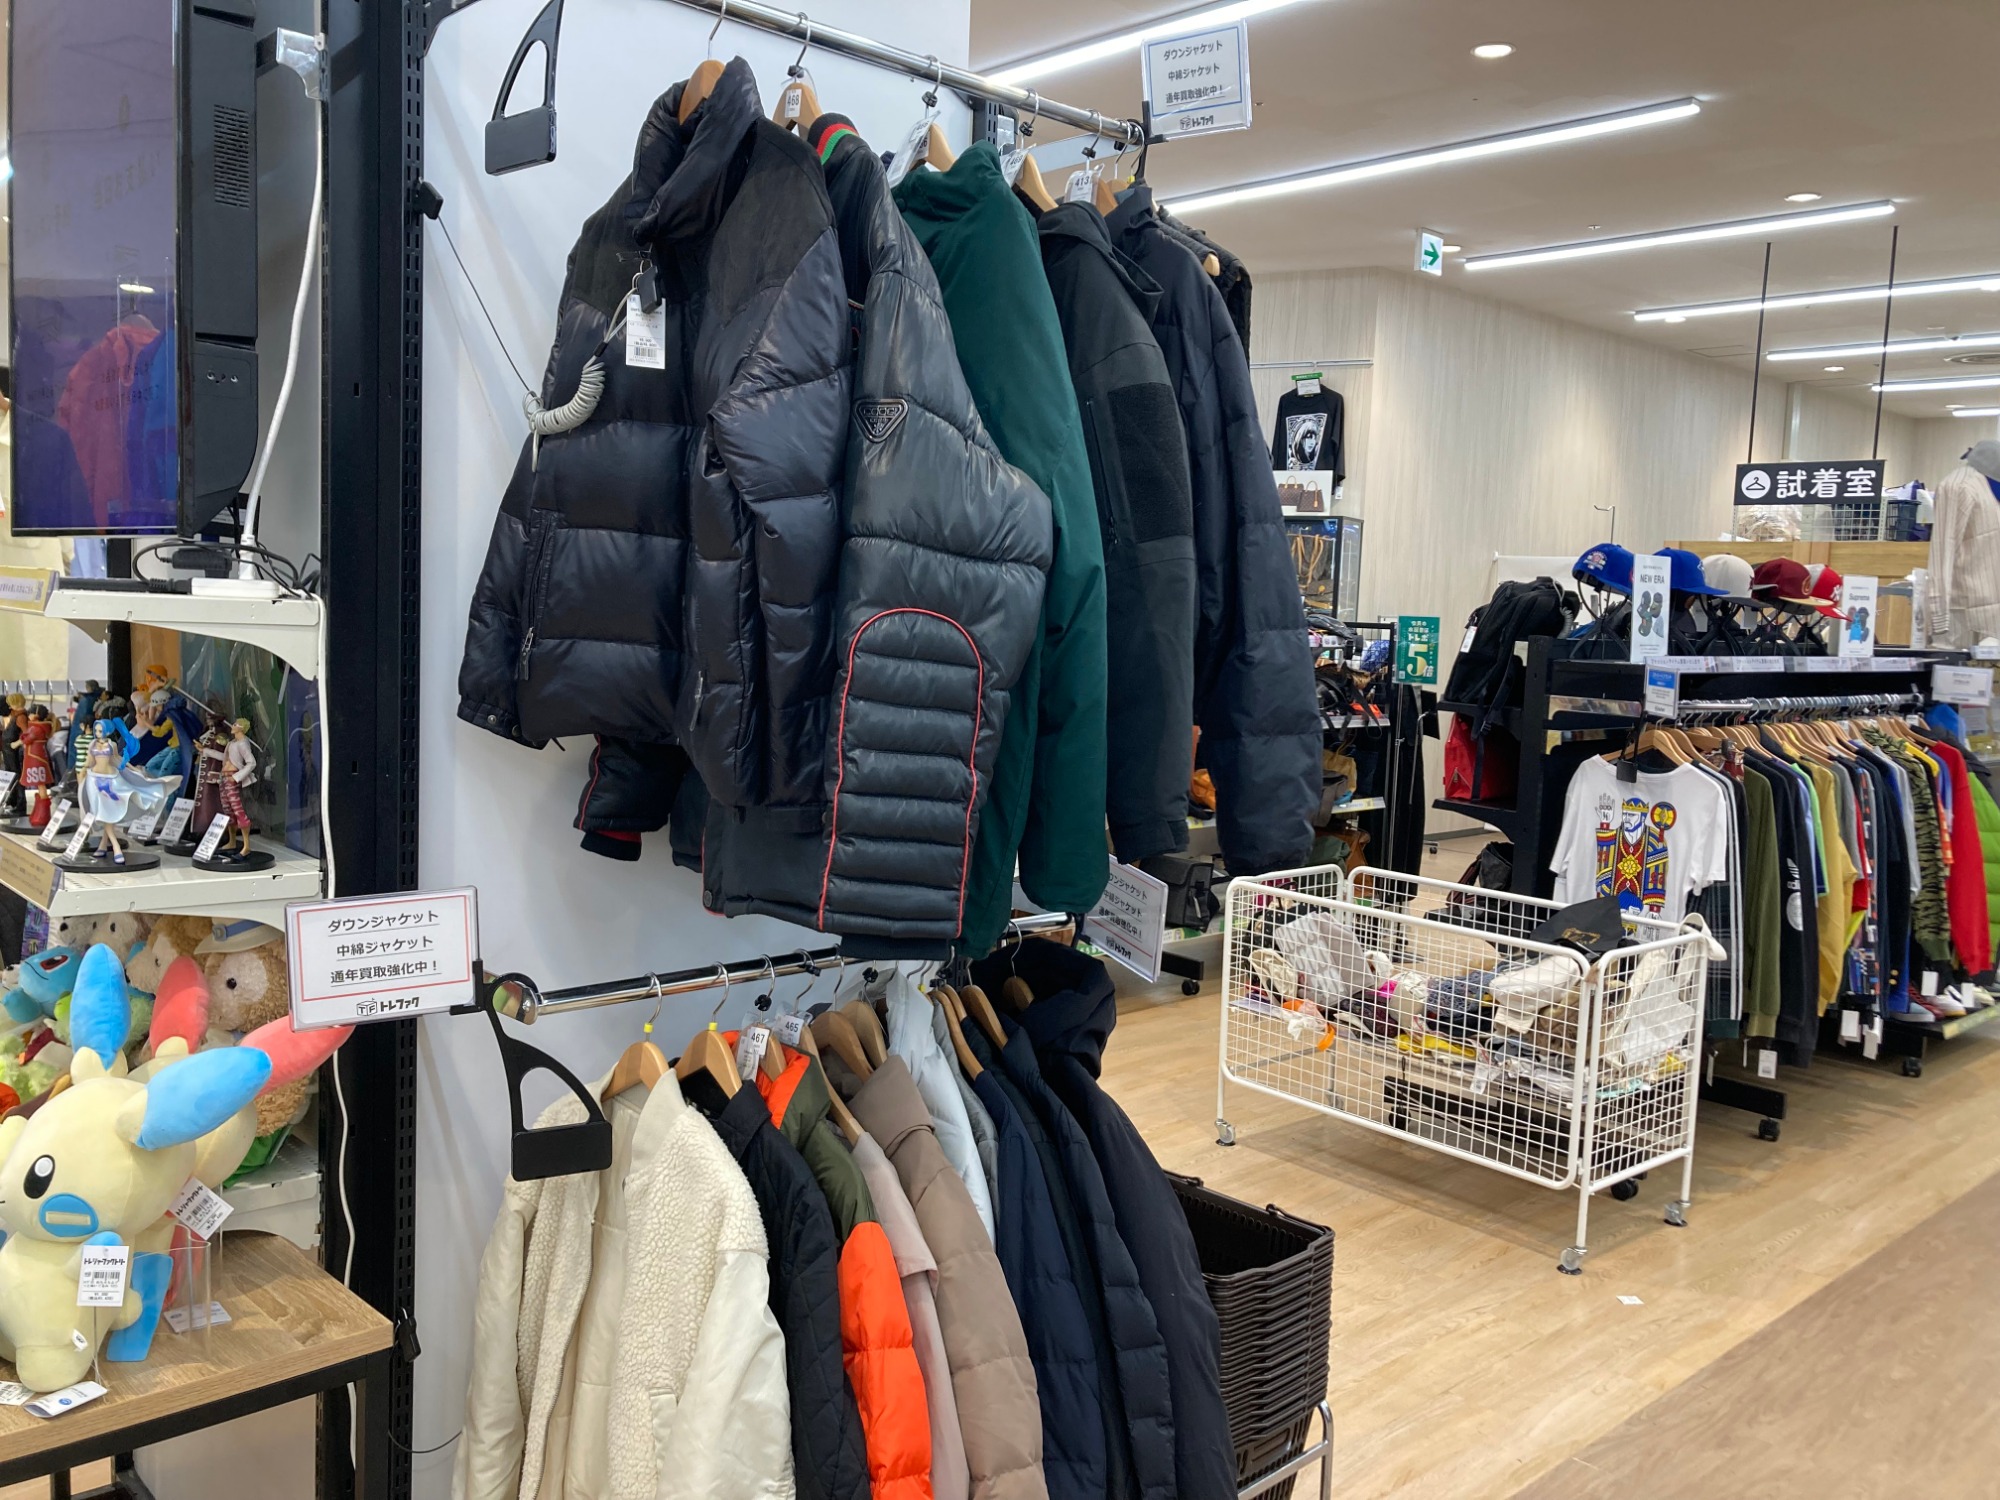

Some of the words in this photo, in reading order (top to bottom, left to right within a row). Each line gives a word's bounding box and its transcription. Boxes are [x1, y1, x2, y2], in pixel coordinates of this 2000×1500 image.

[1163, 39, 1223, 61] ダウンジャケット
[1168, 63, 1220, 81] 中綿ジャケット
[787, 94, 799, 106] 468
[1075, 176, 1089, 187] 413
[1776, 467, 1876, 499] 試着室
[1640, 574, 1652, 584] NEW
[1654, 574, 1665, 584] ERA
[26, 766, 46, 783] SSG
[328, 910, 439, 933] ダウンジャケット
[336, 935, 434, 957] 中綿ジャケット
[330, 960, 438, 984] 通年買取強化中！
[380, 996, 420, 1012] トレファク
[785, 1021, 799, 1032] 465
[751, 1032, 765, 1044] 467
